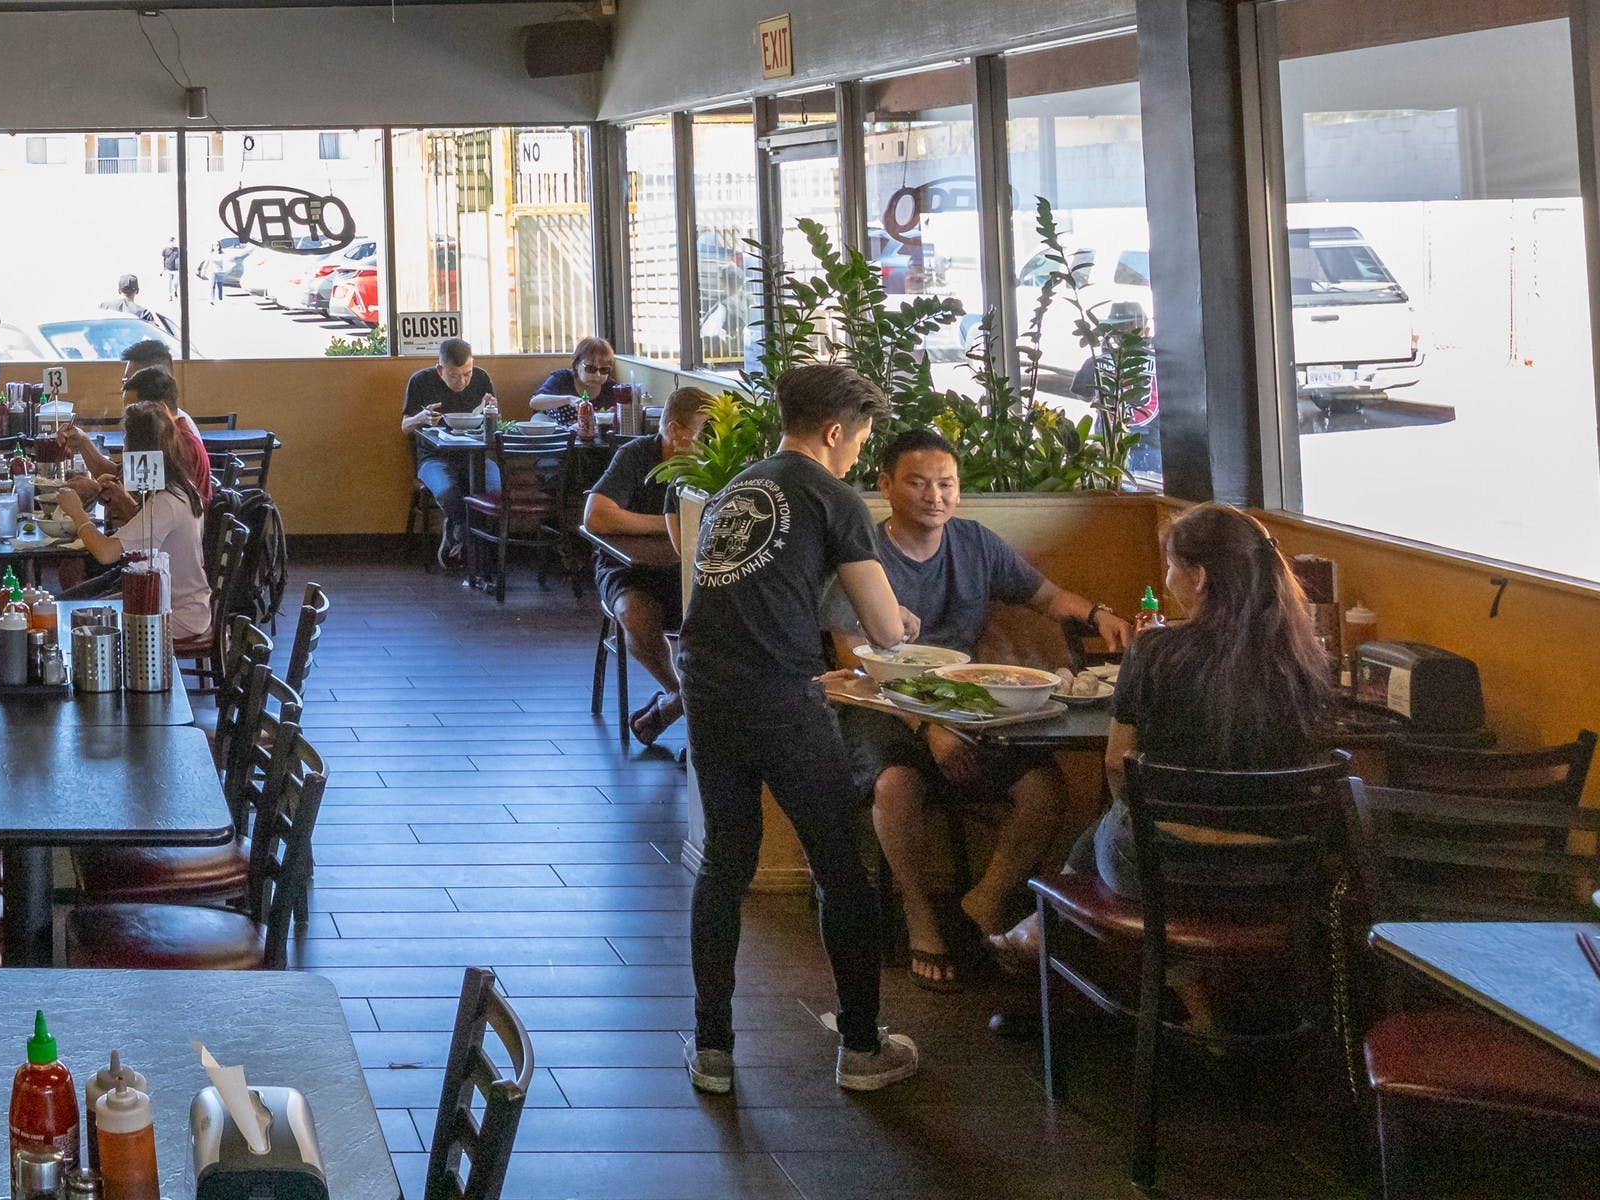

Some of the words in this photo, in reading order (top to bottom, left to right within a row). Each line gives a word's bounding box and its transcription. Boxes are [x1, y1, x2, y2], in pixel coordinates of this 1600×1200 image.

[762, 28, 788, 70] EXIT
[523, 142, 540, 161] NO
[402, 317, 458, 338] CLOSED
[48, 370, 62, 388] 13
[131, 454, 150, 482] 14
[762, 479, 780, 492] SOUP
[775, 491, 786, 502] IN
[779, 502, 791, 533] TOWN
[1490, 576, 1508, 618] 7
